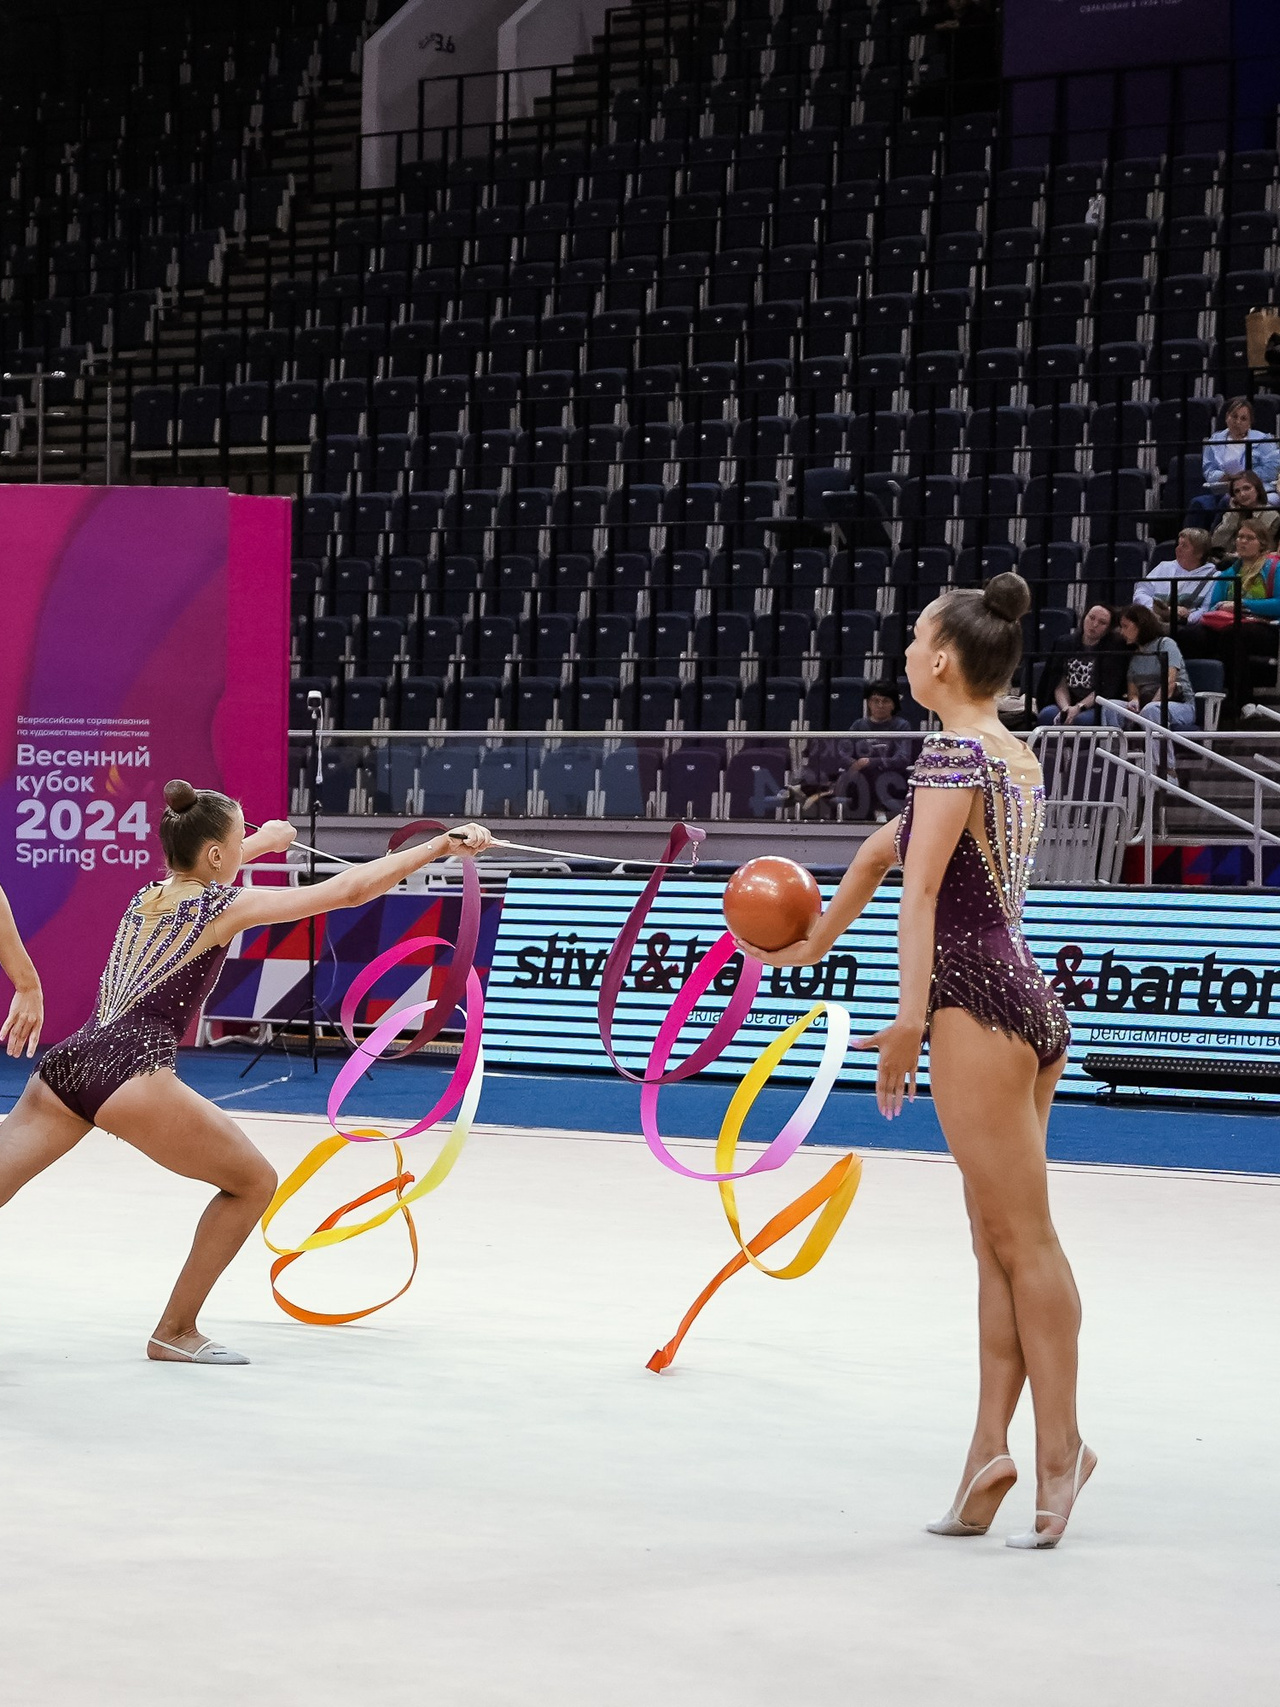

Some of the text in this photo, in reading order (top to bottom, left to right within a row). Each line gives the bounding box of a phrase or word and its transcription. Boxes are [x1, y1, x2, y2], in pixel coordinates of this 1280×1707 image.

[17, 715, 84, 725] Всероссийские
[16, 743, 151, 767] Весенний
[16, 769, 95, 798] кубок
[15, 799, 151, 841] 2024
[16, 843, 151, 871] Spring Cup
[685, 1011, 764, 1025] еклаое
[1090, 1028, 1189, 1044] рекламное
